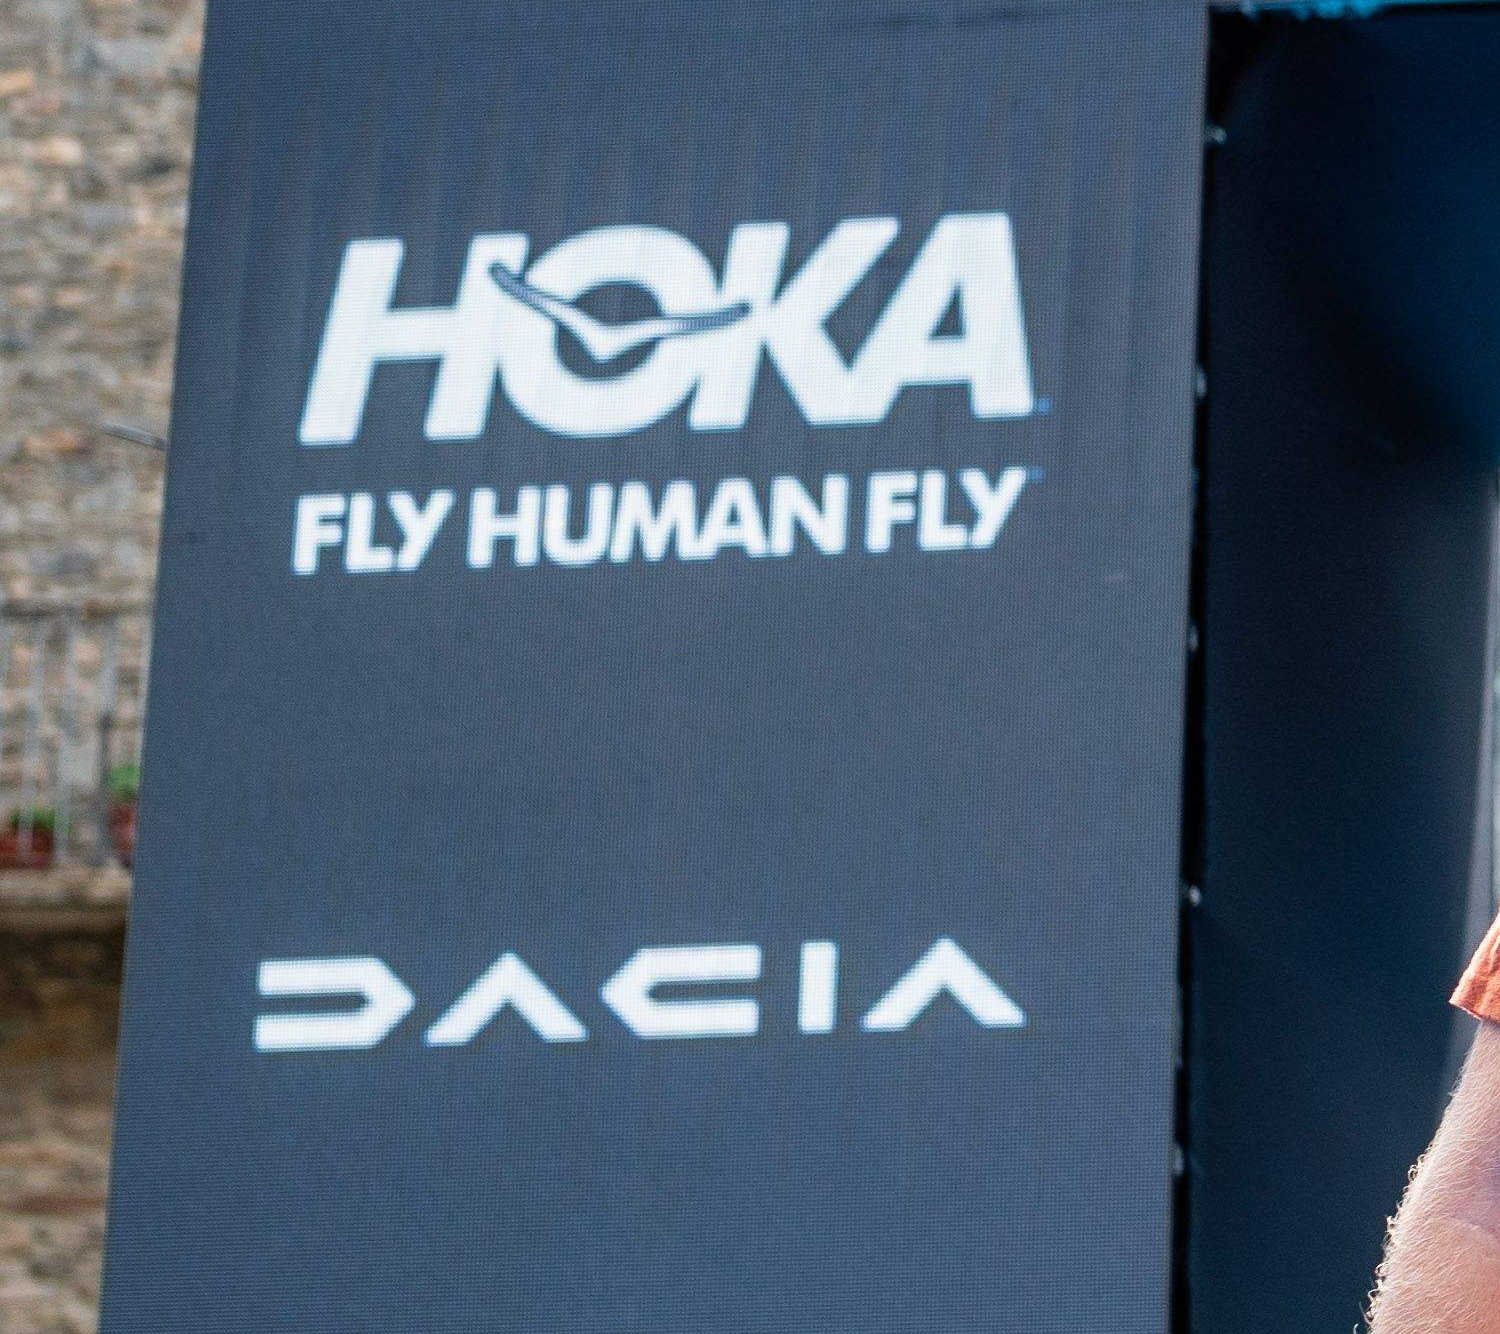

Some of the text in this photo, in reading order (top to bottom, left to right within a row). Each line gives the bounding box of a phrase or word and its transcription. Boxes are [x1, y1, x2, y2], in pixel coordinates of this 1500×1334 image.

[297, 211, 1037, 446] HOKA
[291, 466, 1028, 576] FLY HUMAN FLY
[251, 936, 1029, 1052] DACIA
